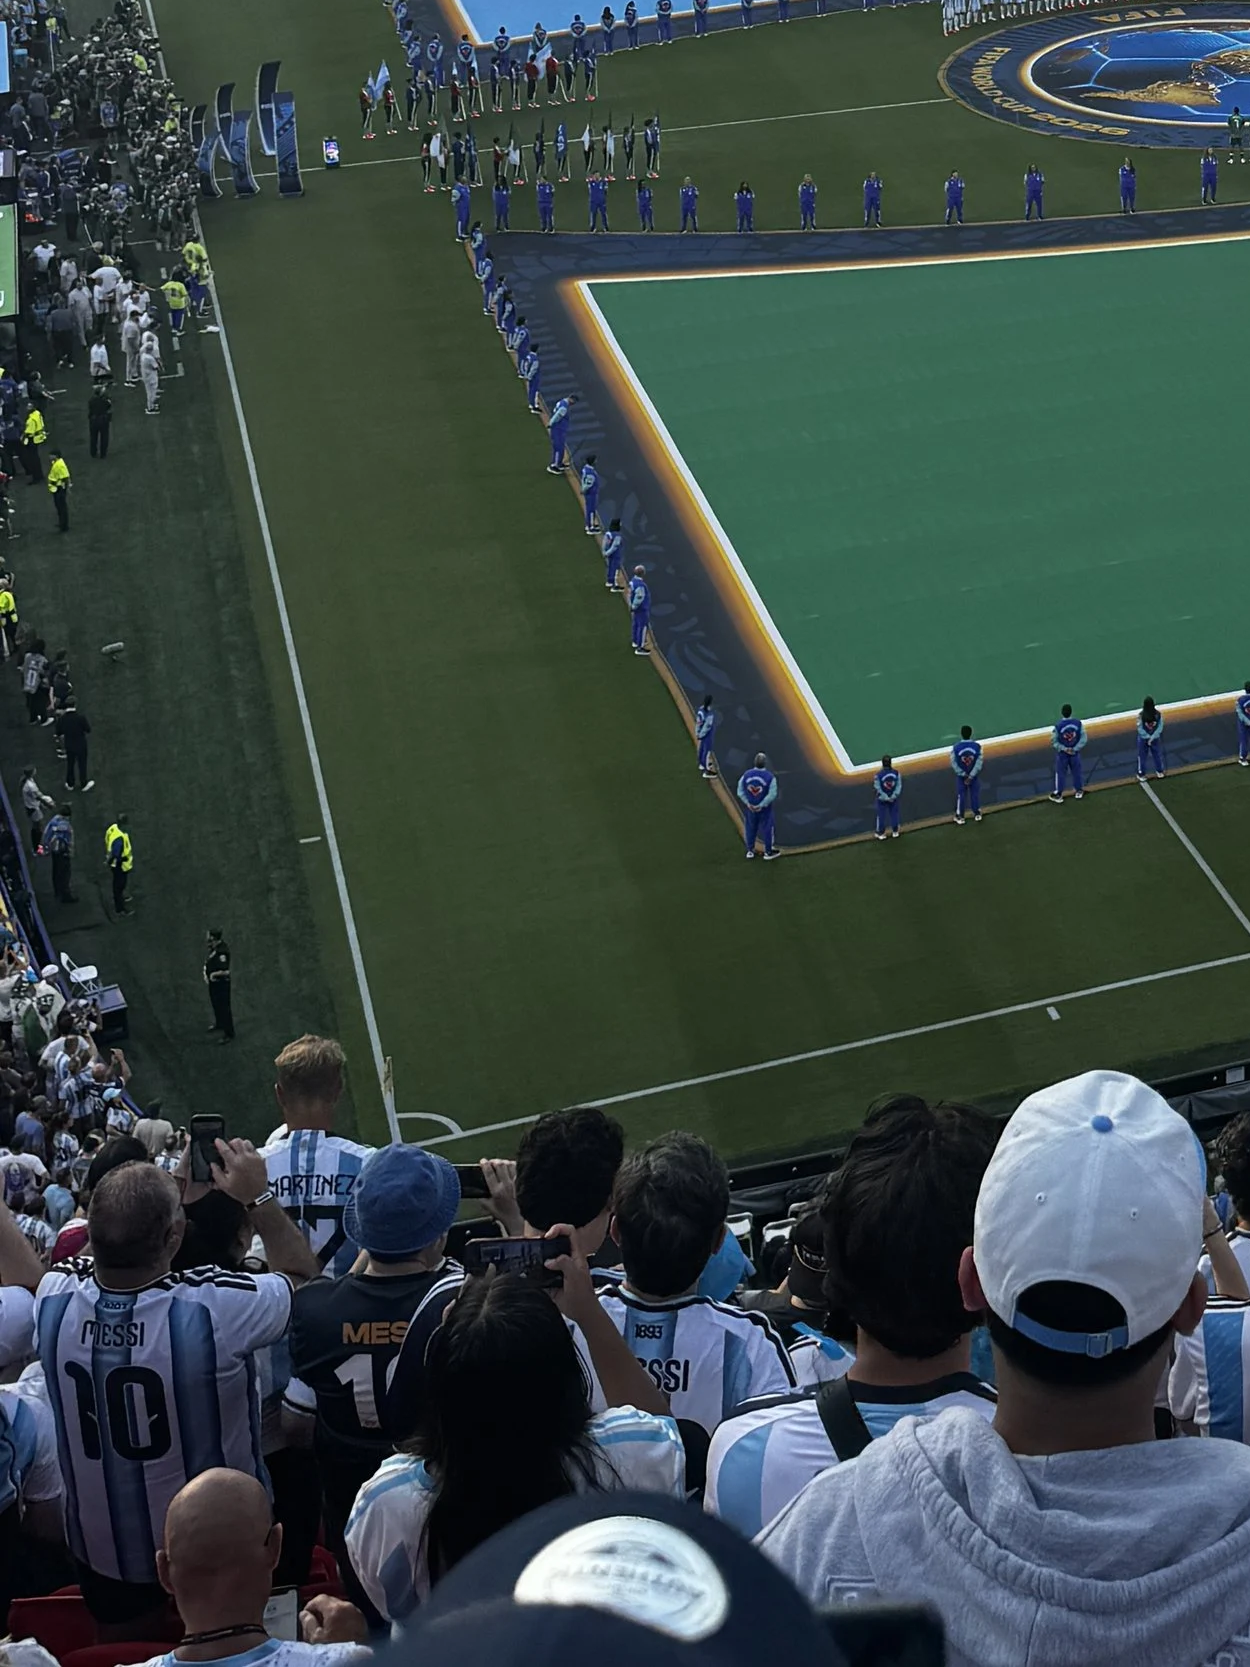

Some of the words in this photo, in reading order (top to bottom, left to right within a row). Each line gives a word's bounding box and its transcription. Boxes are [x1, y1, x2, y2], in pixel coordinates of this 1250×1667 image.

[1091, 7, 1187, 23] FIFA
[974, 46, 1012, 67] FIFA
[970, 66, 998, 97] WORLD
[993, 96, 1037, 114] CUP
[1029, 111, 1131, 136] 2026
[267, 1174, 358, 1197] MARTINEZ
[81, 1319, 145, 1347] MESSI
[635, 1323, 663, 1339] 1893
[636, 1357, 690, 1393] SSI
[64, 1360, 172, 1461] 10
